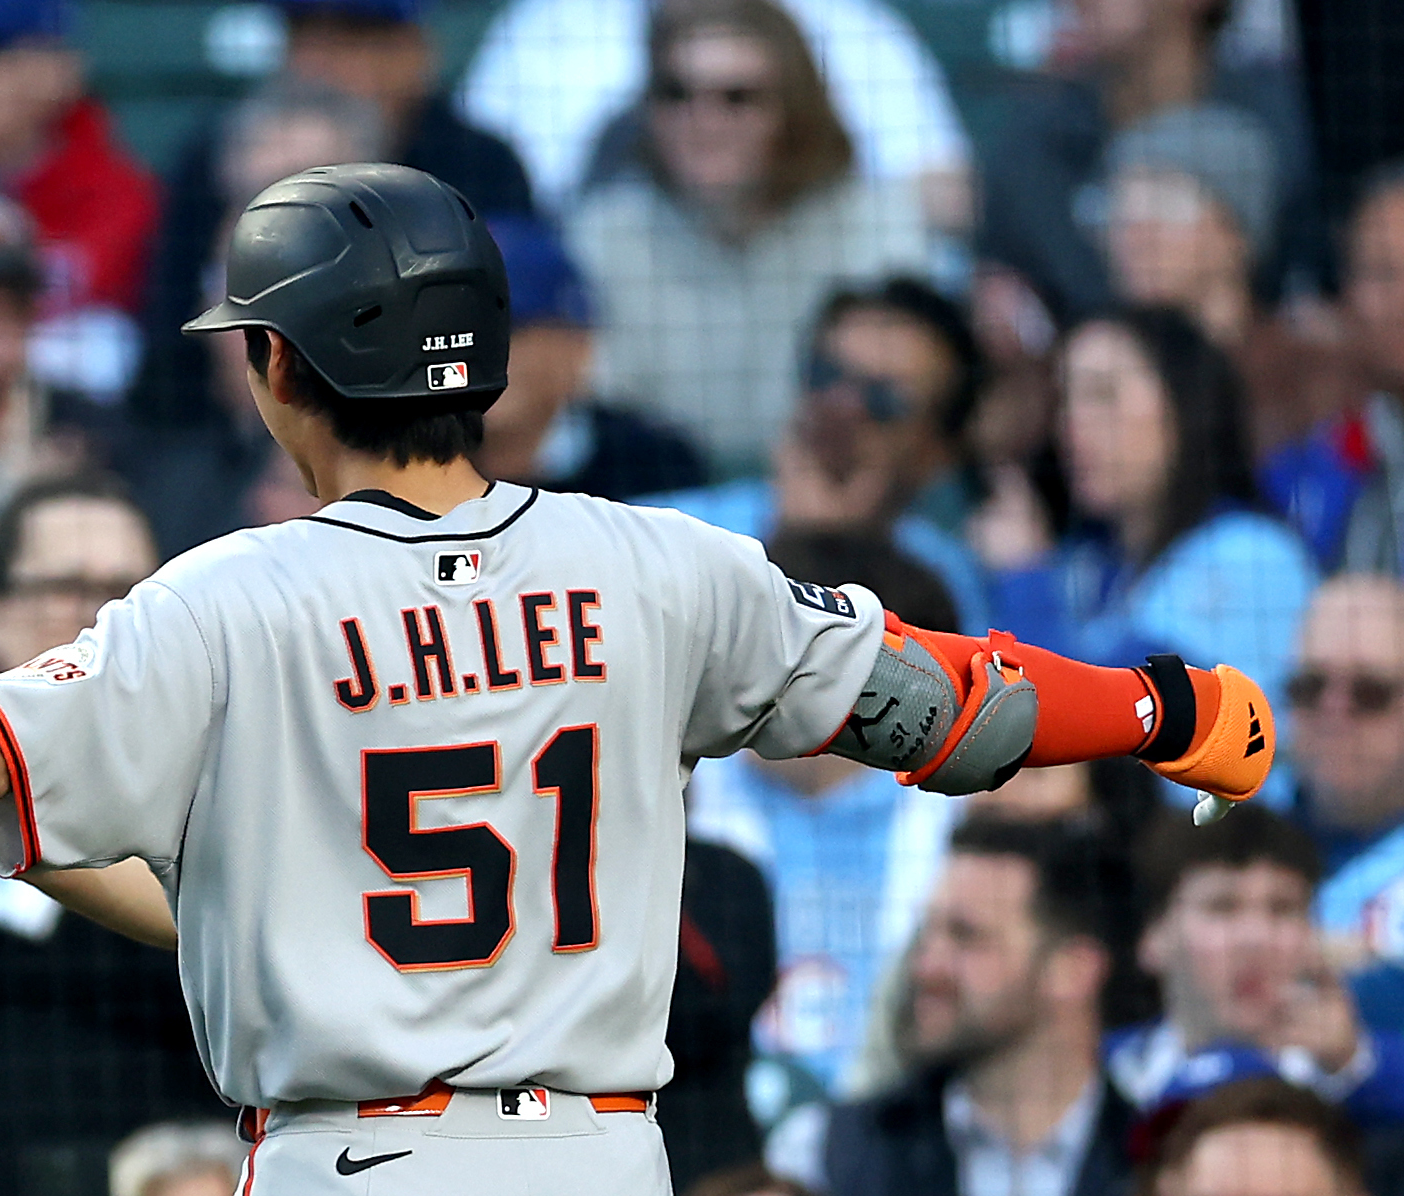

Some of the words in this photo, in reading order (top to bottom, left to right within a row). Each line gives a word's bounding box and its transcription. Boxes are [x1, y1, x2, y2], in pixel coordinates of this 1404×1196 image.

[422, 335, 449, 351] J.H.
[450, 332, 474, 348] LEE
[360, 722, 603, 974] 51
